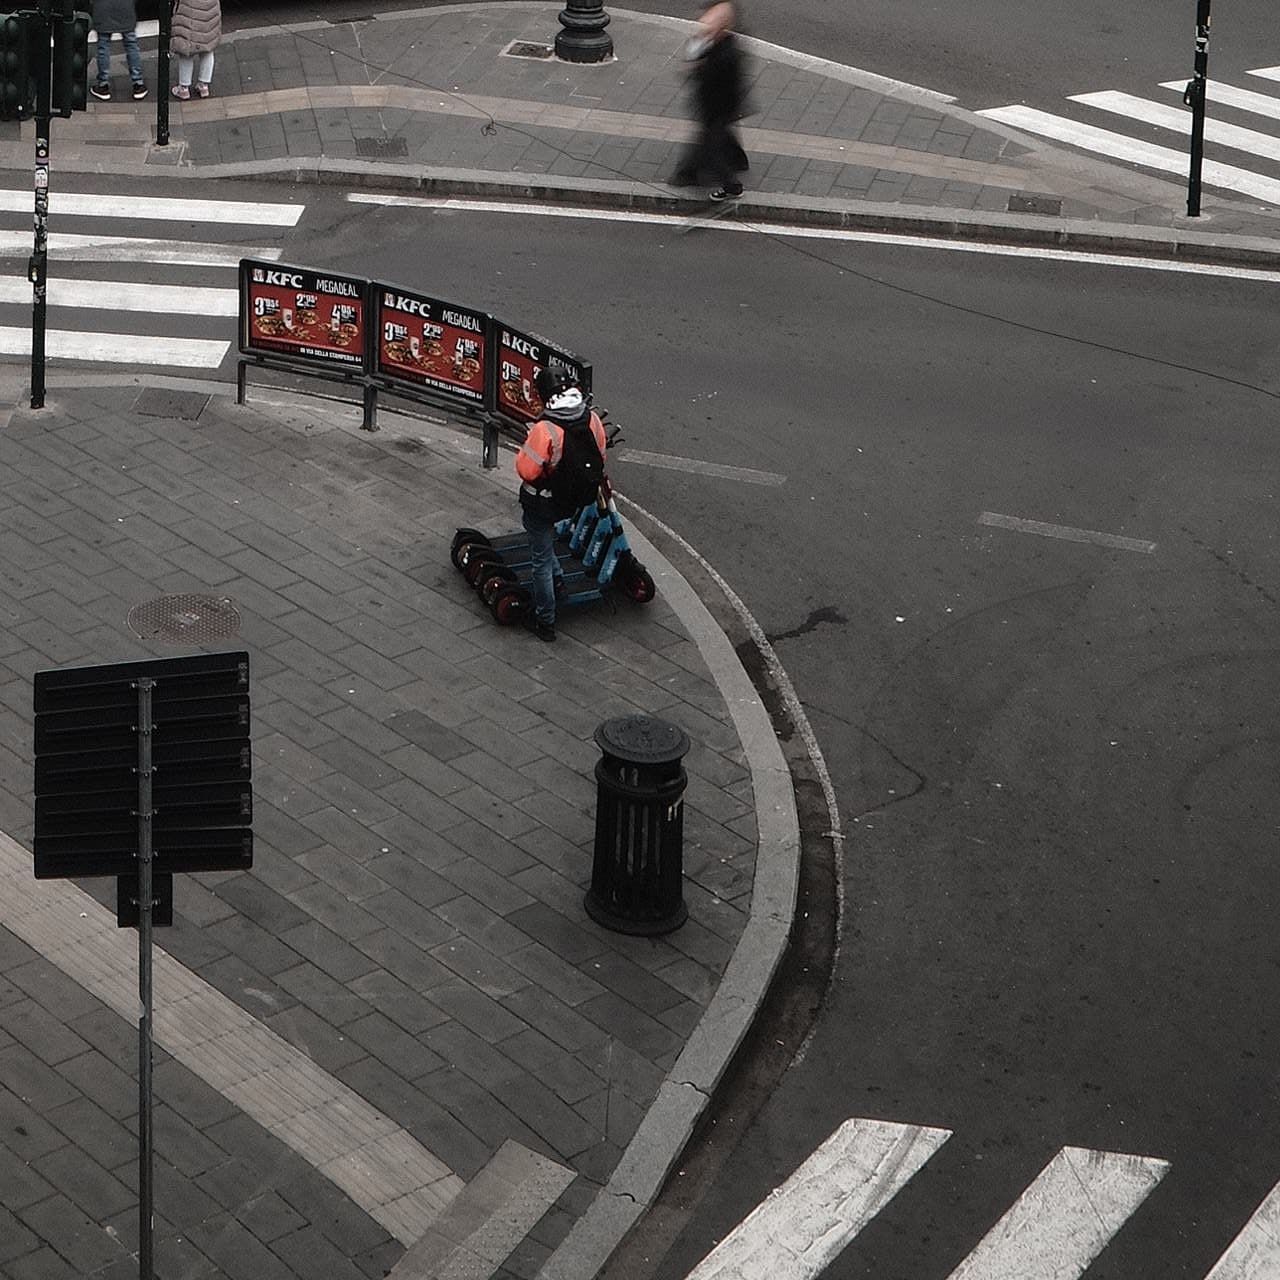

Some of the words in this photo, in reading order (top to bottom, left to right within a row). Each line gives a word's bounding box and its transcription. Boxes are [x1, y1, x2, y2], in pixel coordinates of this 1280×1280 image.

[265, 269, 303, 289] KFC
[316, 278, 360, 298] MEGADEAL
[395, 295, 431, 318] KFC
[442, 309, 483, 333] MEGADEAL
[511, 335, 540, 361] KFC
